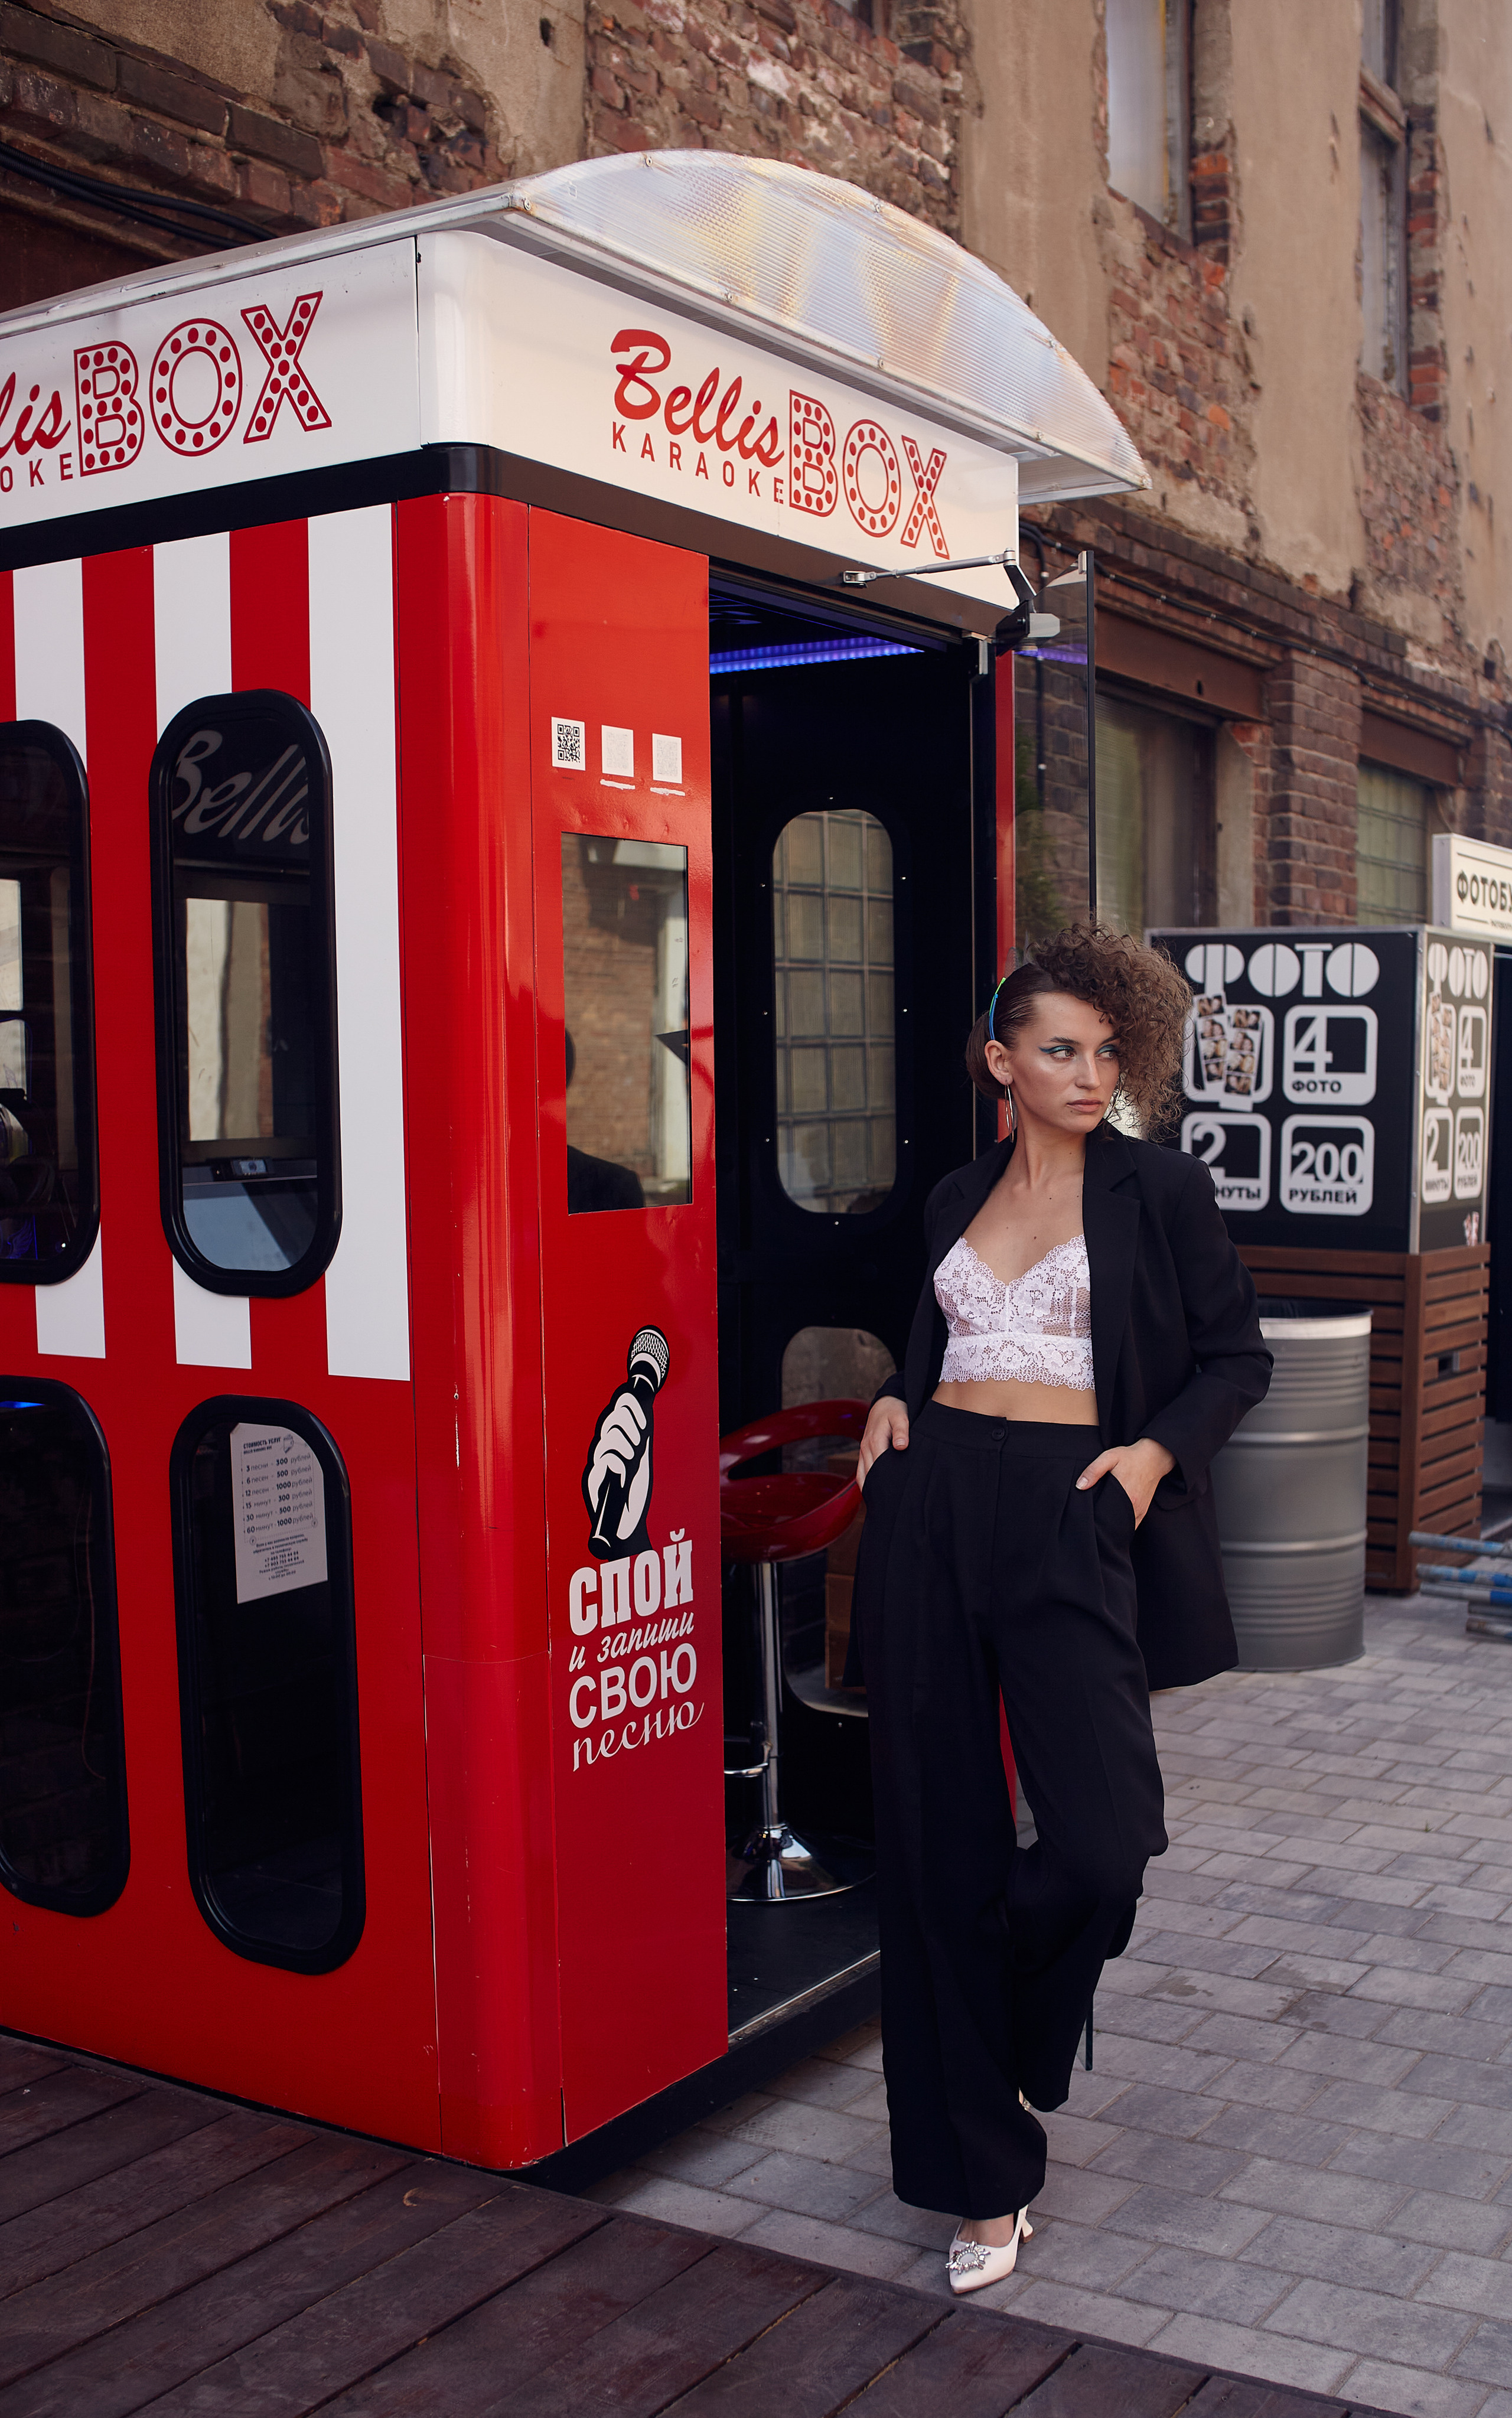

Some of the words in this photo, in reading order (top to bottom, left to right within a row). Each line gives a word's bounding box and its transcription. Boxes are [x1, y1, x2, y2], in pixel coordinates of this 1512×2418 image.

[74, 291, 333, 477] BOX
[610, 328, 784, 468] Bellis
[789, 389, 950, 560] BOX
[612, 421, 784, 504] KARAOKE
[1185, 942, 1380, 998] ФОТО
[1428, 942, 1488, 1000] ФОТО
[1293, 1015, 1334, 1073] 4
[1461, 1015, 1474, 1069] 4
[1292, 1079, 1342, 1094] ФОТО
[1192, 1123, 1227, 1178] 2
[1291, 1142, 1366, 1184] 200
[1426, 1118, 1439, 1172] 2
[1458, 1130, 1481, 1171] 200
[1215, 1185, 1261, 1200] НУТЫ
[1289, 1187, 1357, 1204] РУБЛЕЙ
[276, 1457, 288, 1466] 300
[291, 1454, 311, 1463] рублей
[276, 1481, 291, 1490] 1000
[292, 1478, 312, 1487] рублей
[277, 1469, 288, 1478] 500
[291, 1465, 311, 1475] рублей
[246, 1514, 253, 1522] 30
[279, 1505, 291, 1514] 500
[292, 1501, 312, 1511] рублей
[278, 1493, 289, 1503] 300
[292, 1489, 312, 1499] рублей
[247, 1526, 255, 1534] 60
[277, 1517, 292, 1527] 1000
[292, 1513, 313, 1524] рублей
[569, 1528, 694, 1637] СПОЙ
[568, 1643, 586, 1673] и
[596, 1609, 695, 1665] запиши
[569, 1643, 698, 1730] СВОЮ
[572, 1701, 705, 1772] песню
